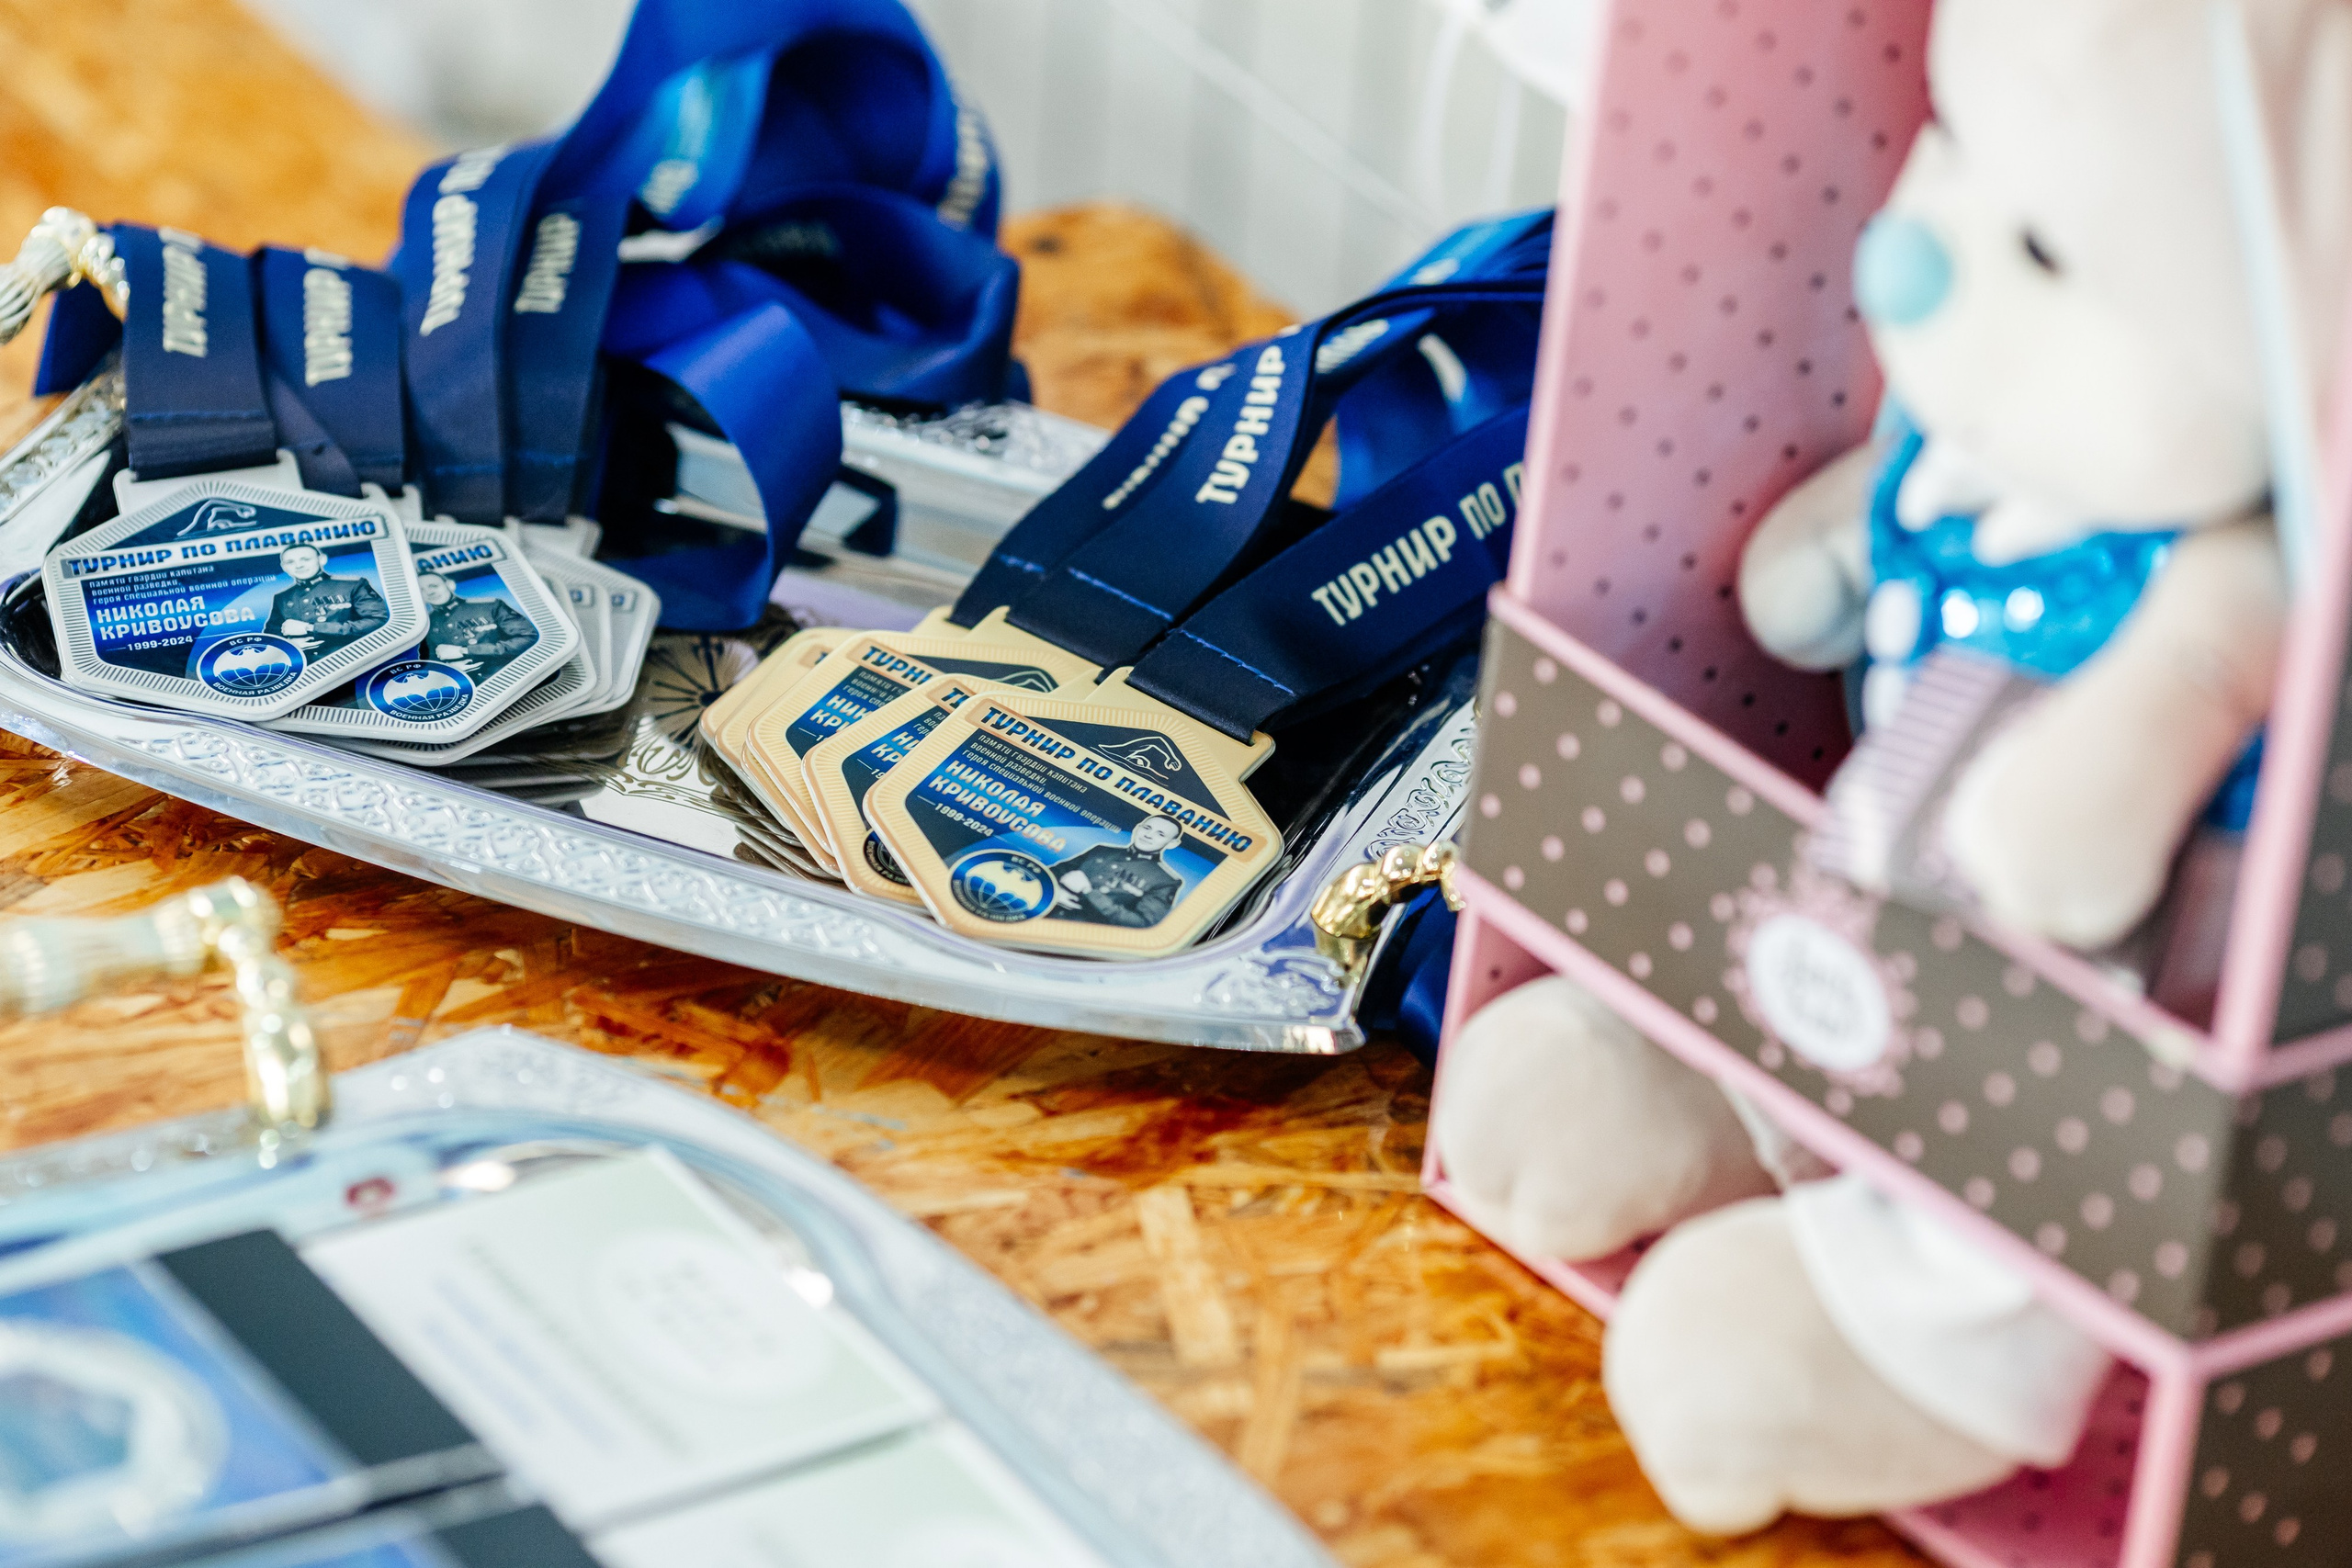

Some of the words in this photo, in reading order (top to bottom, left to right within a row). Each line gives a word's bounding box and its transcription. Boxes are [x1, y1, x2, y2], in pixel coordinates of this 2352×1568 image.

[1195, 344, 1286, 504] ТУРНИР
[67, 549, 172, 576] ТУРНИР
[180, 543, 218, 558] ПО
[225, 520, 377, 552] ПЛАВАНИЮ
[1311, 515, 1457, 626] ТУРНИР
[1458, 481, 1508, 540] ПО
[92, 585, 131, 596] военной
[93, 594, 121, 605] героя
[123, 586, 187, 601] специальной
[188, 580, 229, 592] военной
[231, 574, 277, 586] операции
[128, 571, 167, 583] гвардии
[169, 565, 215, 578] капитана
[96, 595, 206, 624] НИКОЛАЯ
[99, 606, 255, 640] КРИВОУСОВА
[127, 635, 194, 651] 1999-2024
[212, 682, 255, 695] ВОЕННАЯ
[257, 671, 299, 694] РАЗВЕДКА
[390, 666, 403, 675] ВС
[389, 709, 435, 721] ВОЕННАЯ
[435, 694, 469, 718] РАЗВЕДКА
[970, 741, 1008, 764] военной
[1004, 761, 1047, 786] разведки,
[980, 705, 1076, 761] ТУРНИР
[1076, 756, 1114, 781] ПО
[1114, 776, 1254, 852] ПЛАВАНИЮ
[1011, 751, 1048, 773] гвардии
[1046, 770, 1088, 794] капитана
[944, 760, 1046, 818] НИКОЛАЯ
[961, 750, 989, 766] героя
[988, 762, 1046, 795] специальной
[1043, 791, 1081, 814] военной
[1080, 809, 1123, 834] операции
[928, 775, 1067, 852] КРИВОУСОВА
[934, 803, 995, 837] 1999-2024
